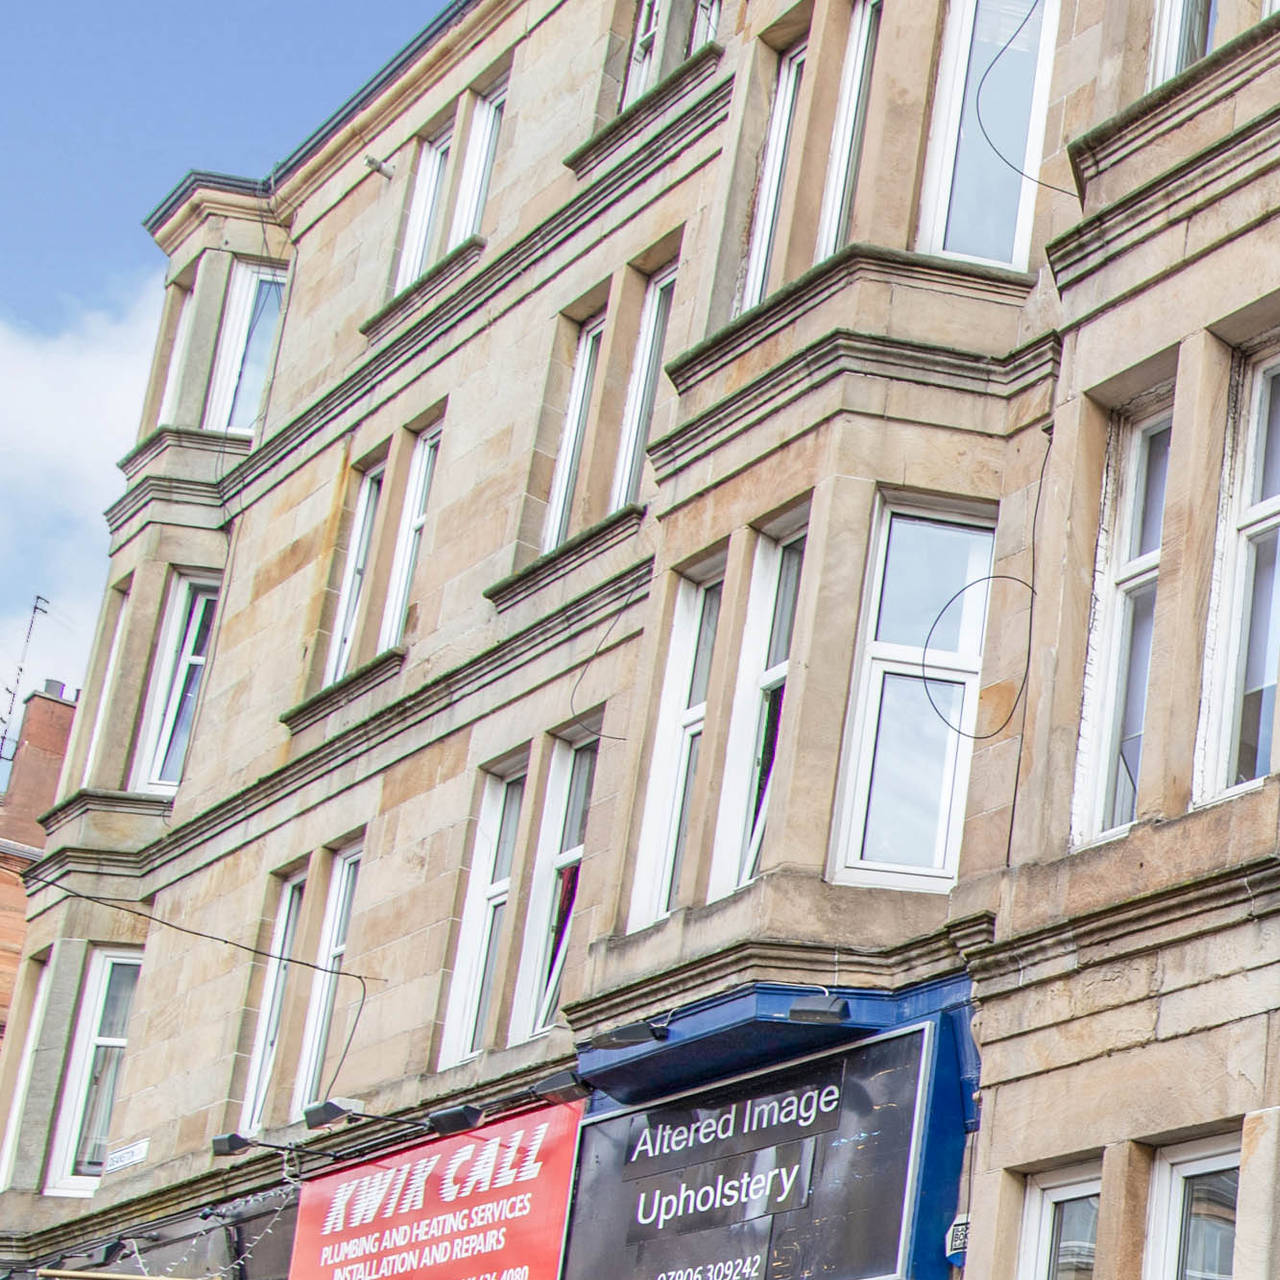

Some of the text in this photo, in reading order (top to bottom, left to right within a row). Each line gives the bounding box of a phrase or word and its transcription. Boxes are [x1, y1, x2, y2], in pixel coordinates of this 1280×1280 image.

[630, 1085, 839, 1163] Altered Image
[321, 1123, 549, 1235] KWIK CALL
[636, 1164, 800, 1229] Upholstery
[320, 1193, 532, 1267] PLUMBING AND HEATING SERVICES
[420, 1243, 451, 1268] AND
[451, 1228, 507, 1261] REPAIRS
